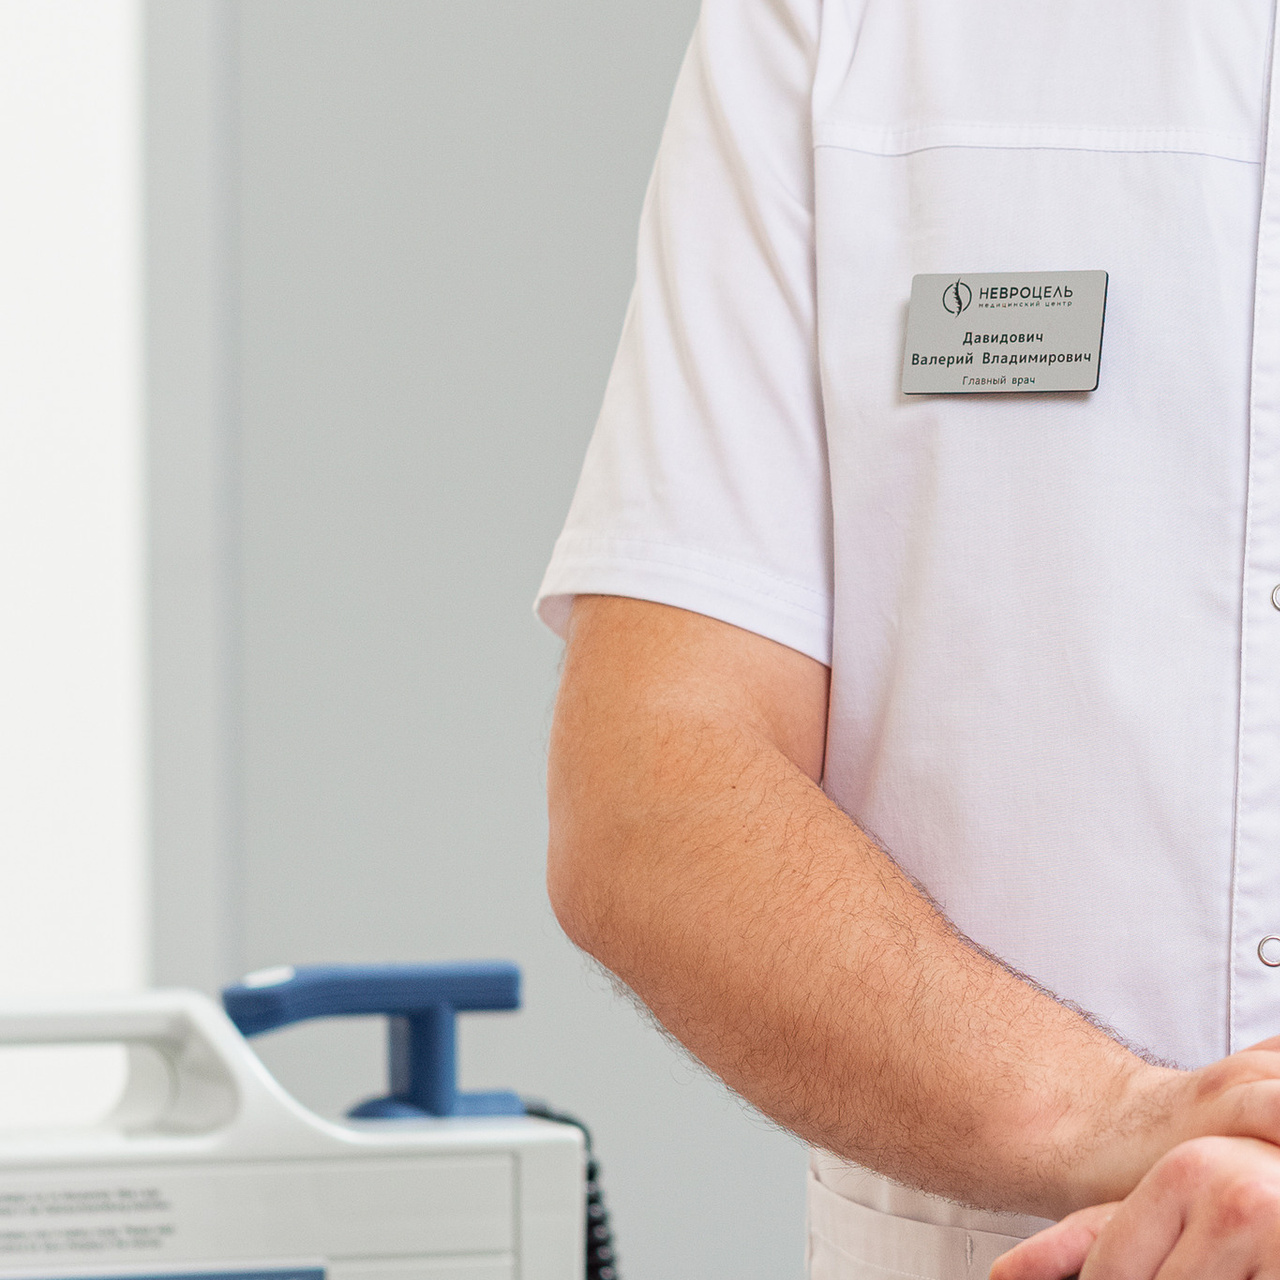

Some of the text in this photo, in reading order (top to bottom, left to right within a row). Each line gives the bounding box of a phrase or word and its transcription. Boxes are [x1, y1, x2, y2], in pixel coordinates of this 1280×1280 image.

[979, 286, 1073, 300] НЕВРОЦЕЛЬ
[963, 332, 1043, 345] Давидович
[911, 352, 1091, 368] Валерий Владимирович
[962, 375, 1035, 386] Главный врач
